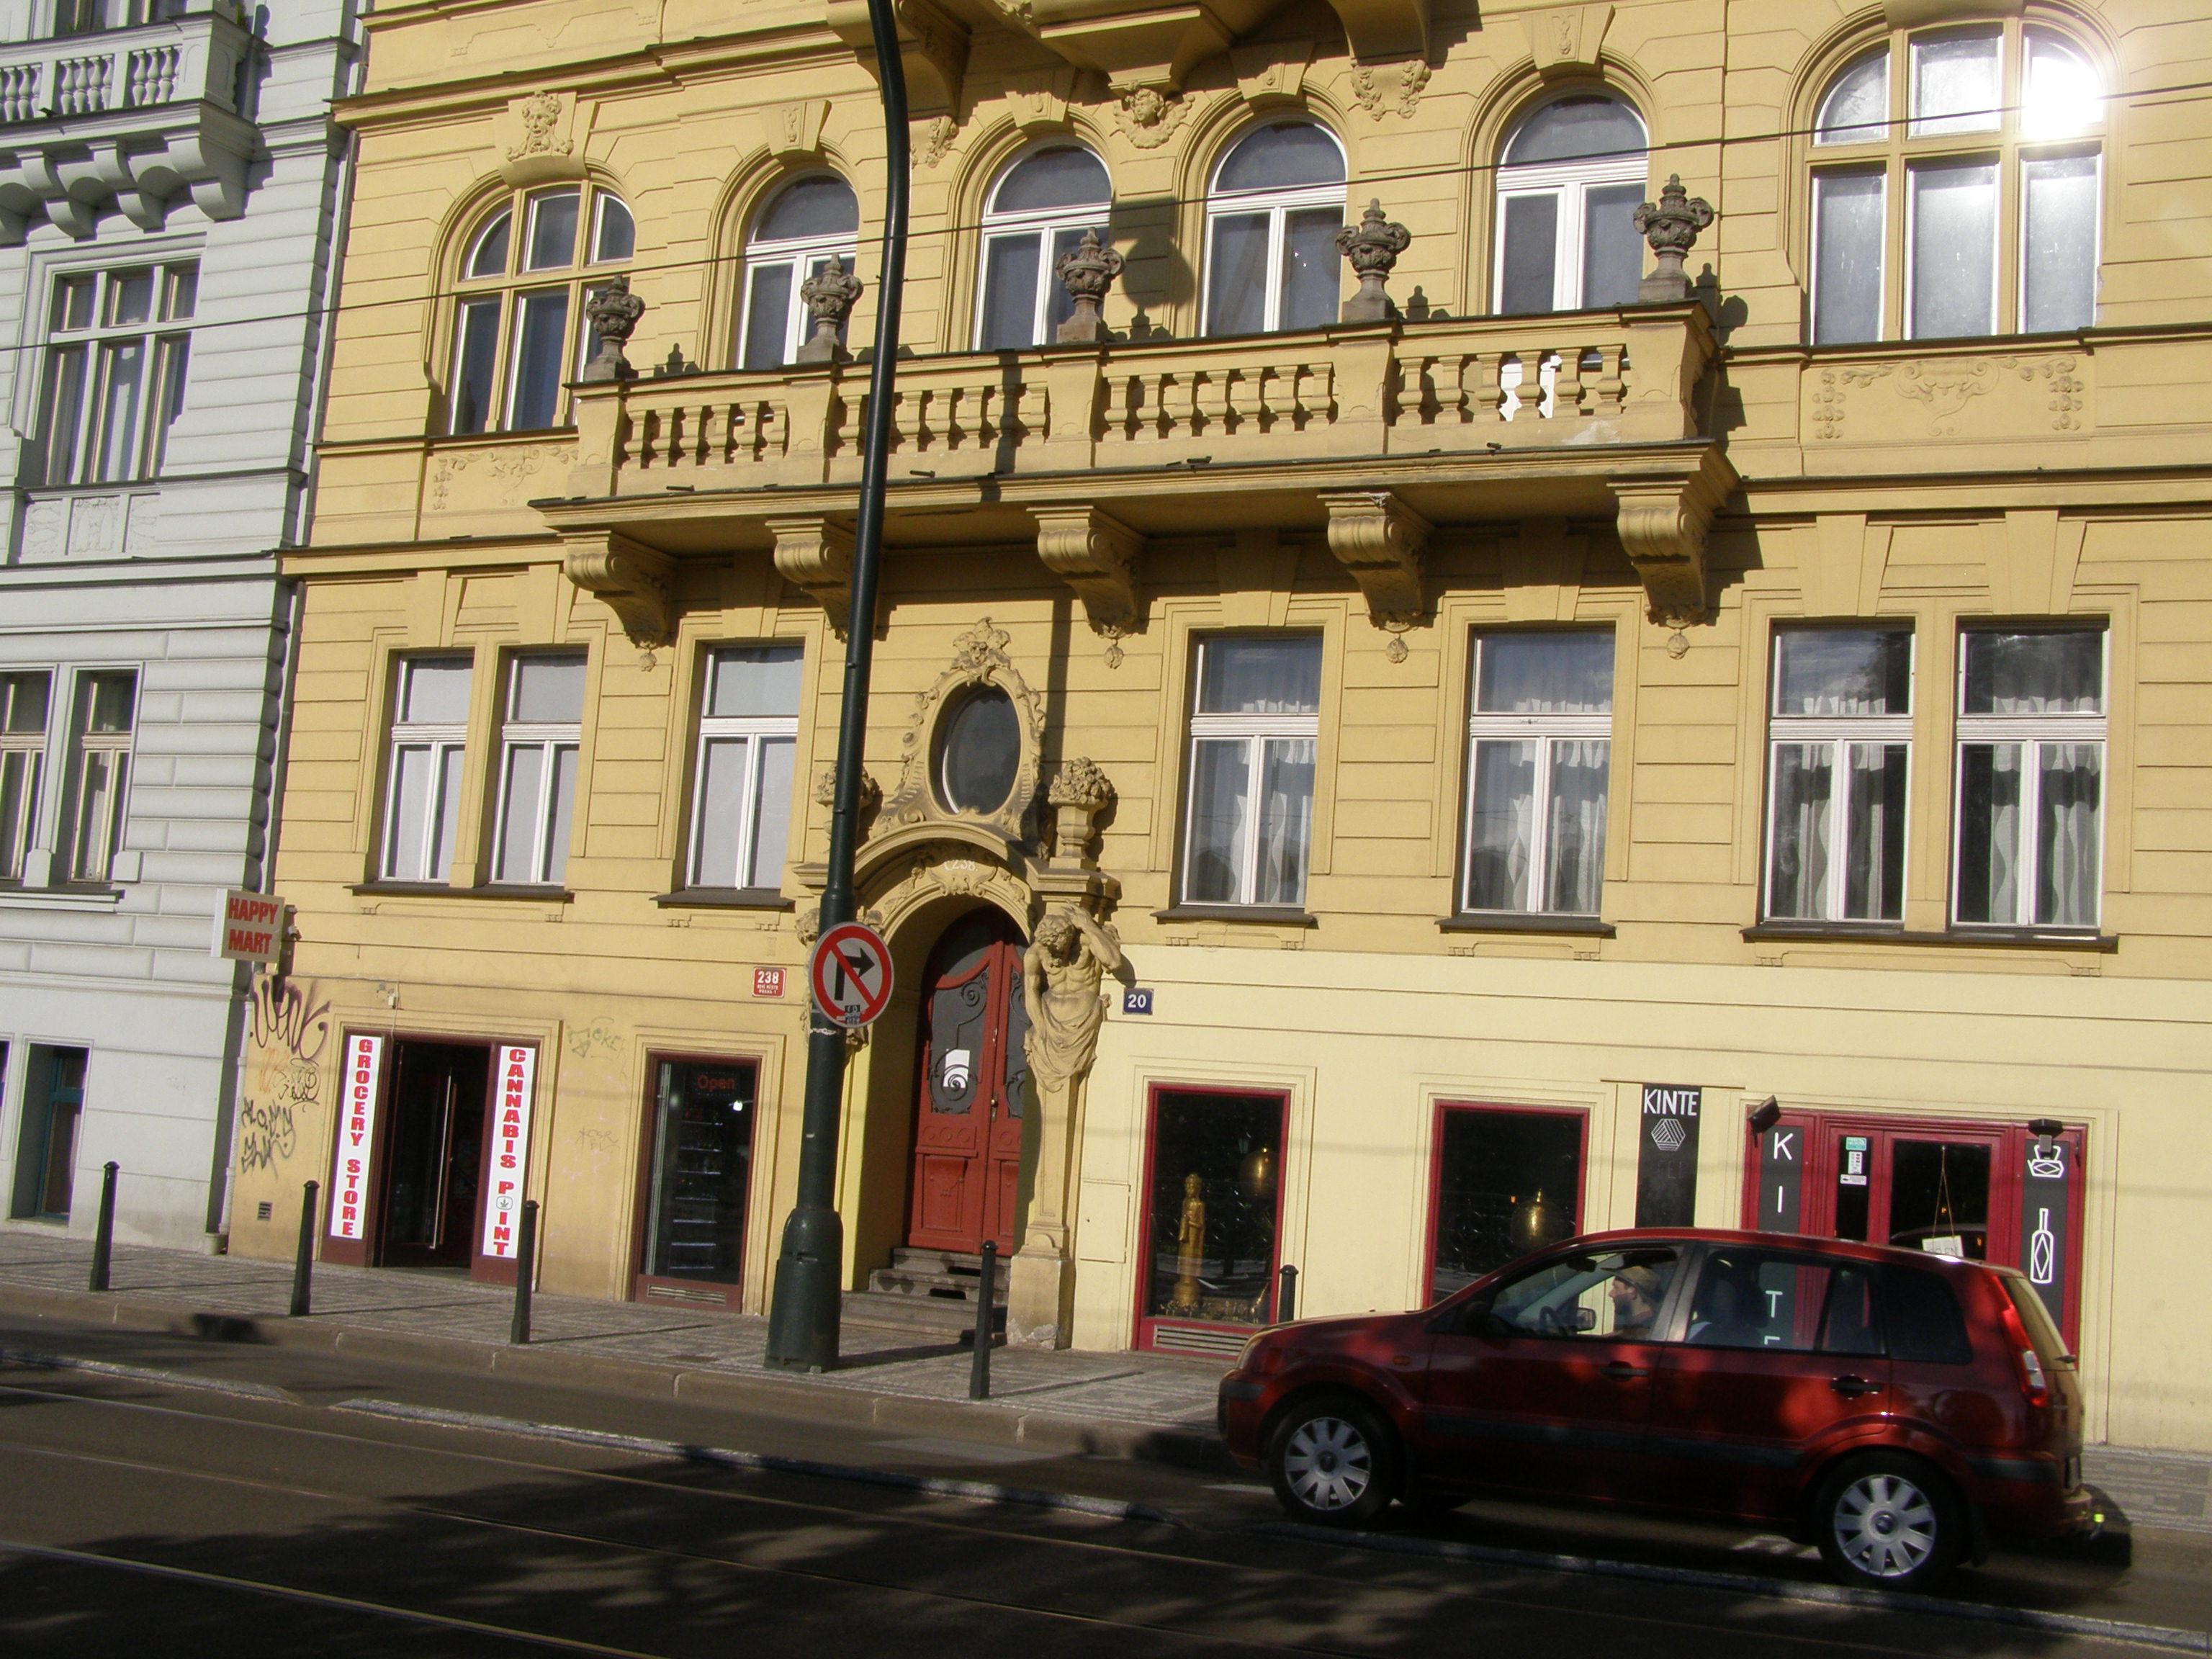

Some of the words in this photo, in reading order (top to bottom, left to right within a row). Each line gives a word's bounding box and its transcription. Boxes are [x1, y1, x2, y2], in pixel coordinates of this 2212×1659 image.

[228, 897, 279, 925] HAPPY
[228, 929, 272, 955] MART
[757, 971, 779, 984] 238
[1128, 994, 1147, 1008] 20
[350, 1038, 373, 1146] GROCERY
[1643, 1089, 1699, 1116] KINTE
[500, 1049, 526, 1168] CANNABIS
[342, 1159, 361, 1236] STORE
